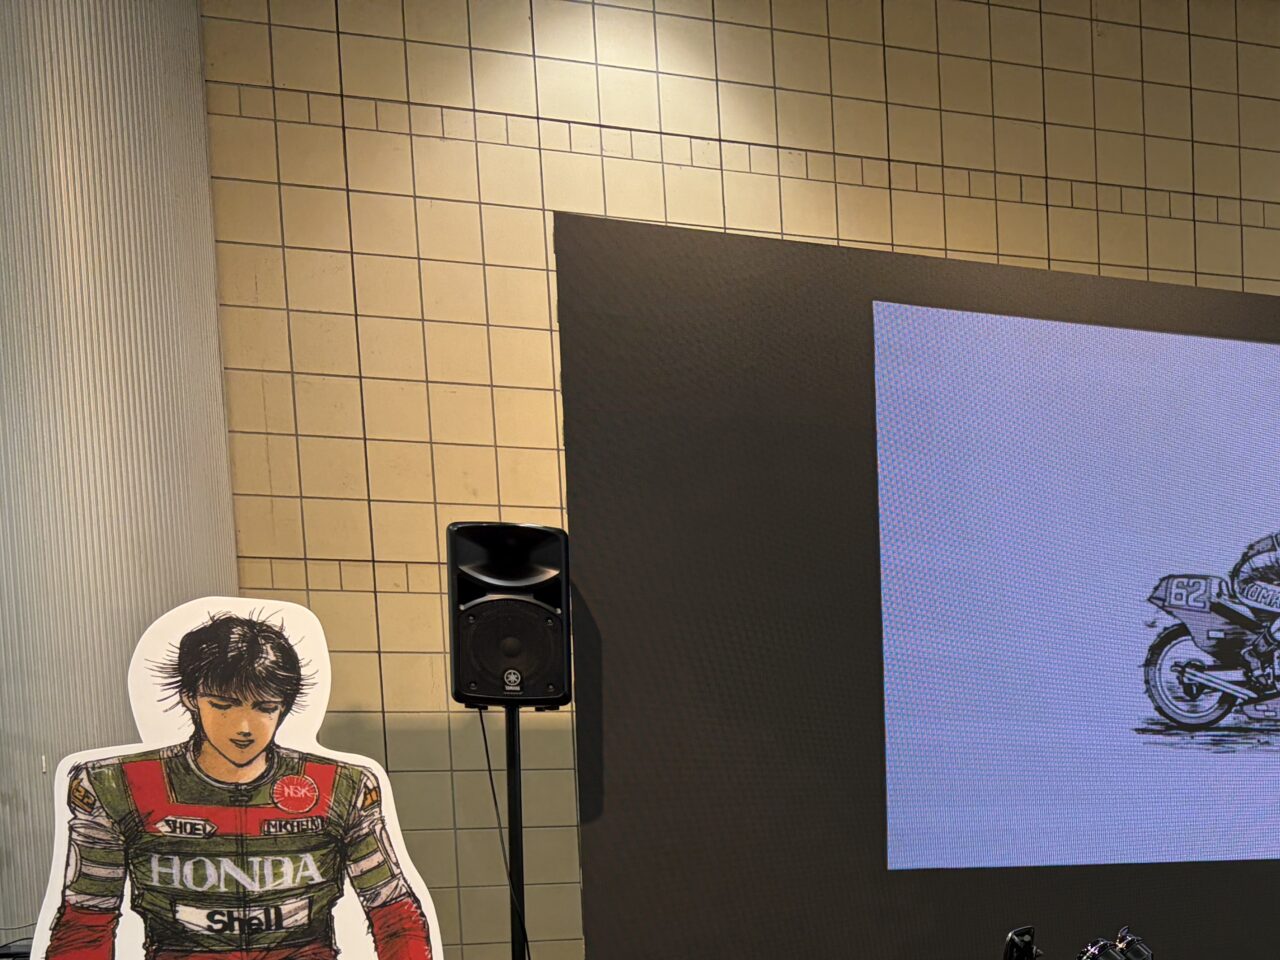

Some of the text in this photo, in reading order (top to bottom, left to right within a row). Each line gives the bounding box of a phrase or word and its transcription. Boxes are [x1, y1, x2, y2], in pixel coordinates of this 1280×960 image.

[1169, 578, 1206, 608] 62
[284, 785, 312, 798] NSK
[151, 852, 327, 893] HONDA
[206, 906, 284, 935] Shell
